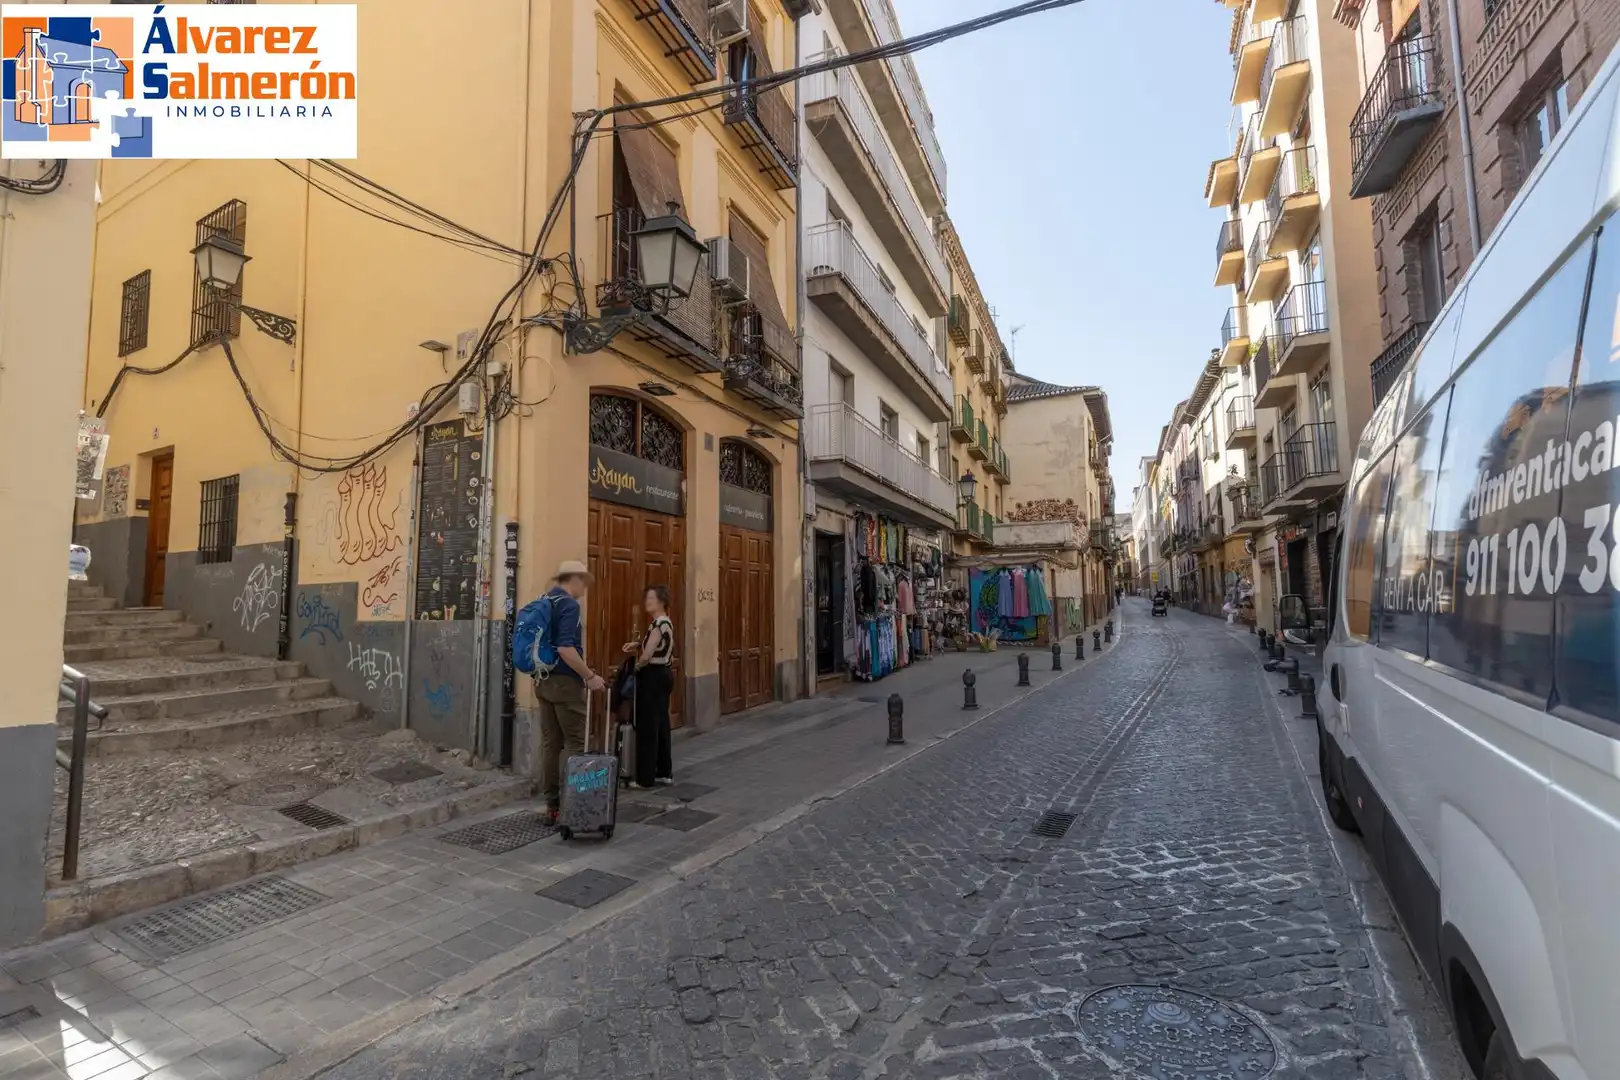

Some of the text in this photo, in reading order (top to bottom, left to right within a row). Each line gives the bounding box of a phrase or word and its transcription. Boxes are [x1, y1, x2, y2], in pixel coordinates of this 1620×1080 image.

[588, 455, 679, 501] Rayan restaurante
[1465, 533, 1500, 597] 911
[1507, 516, 1567, 595] 100
[1383, 568, 1444, 614] RENT A CAR
